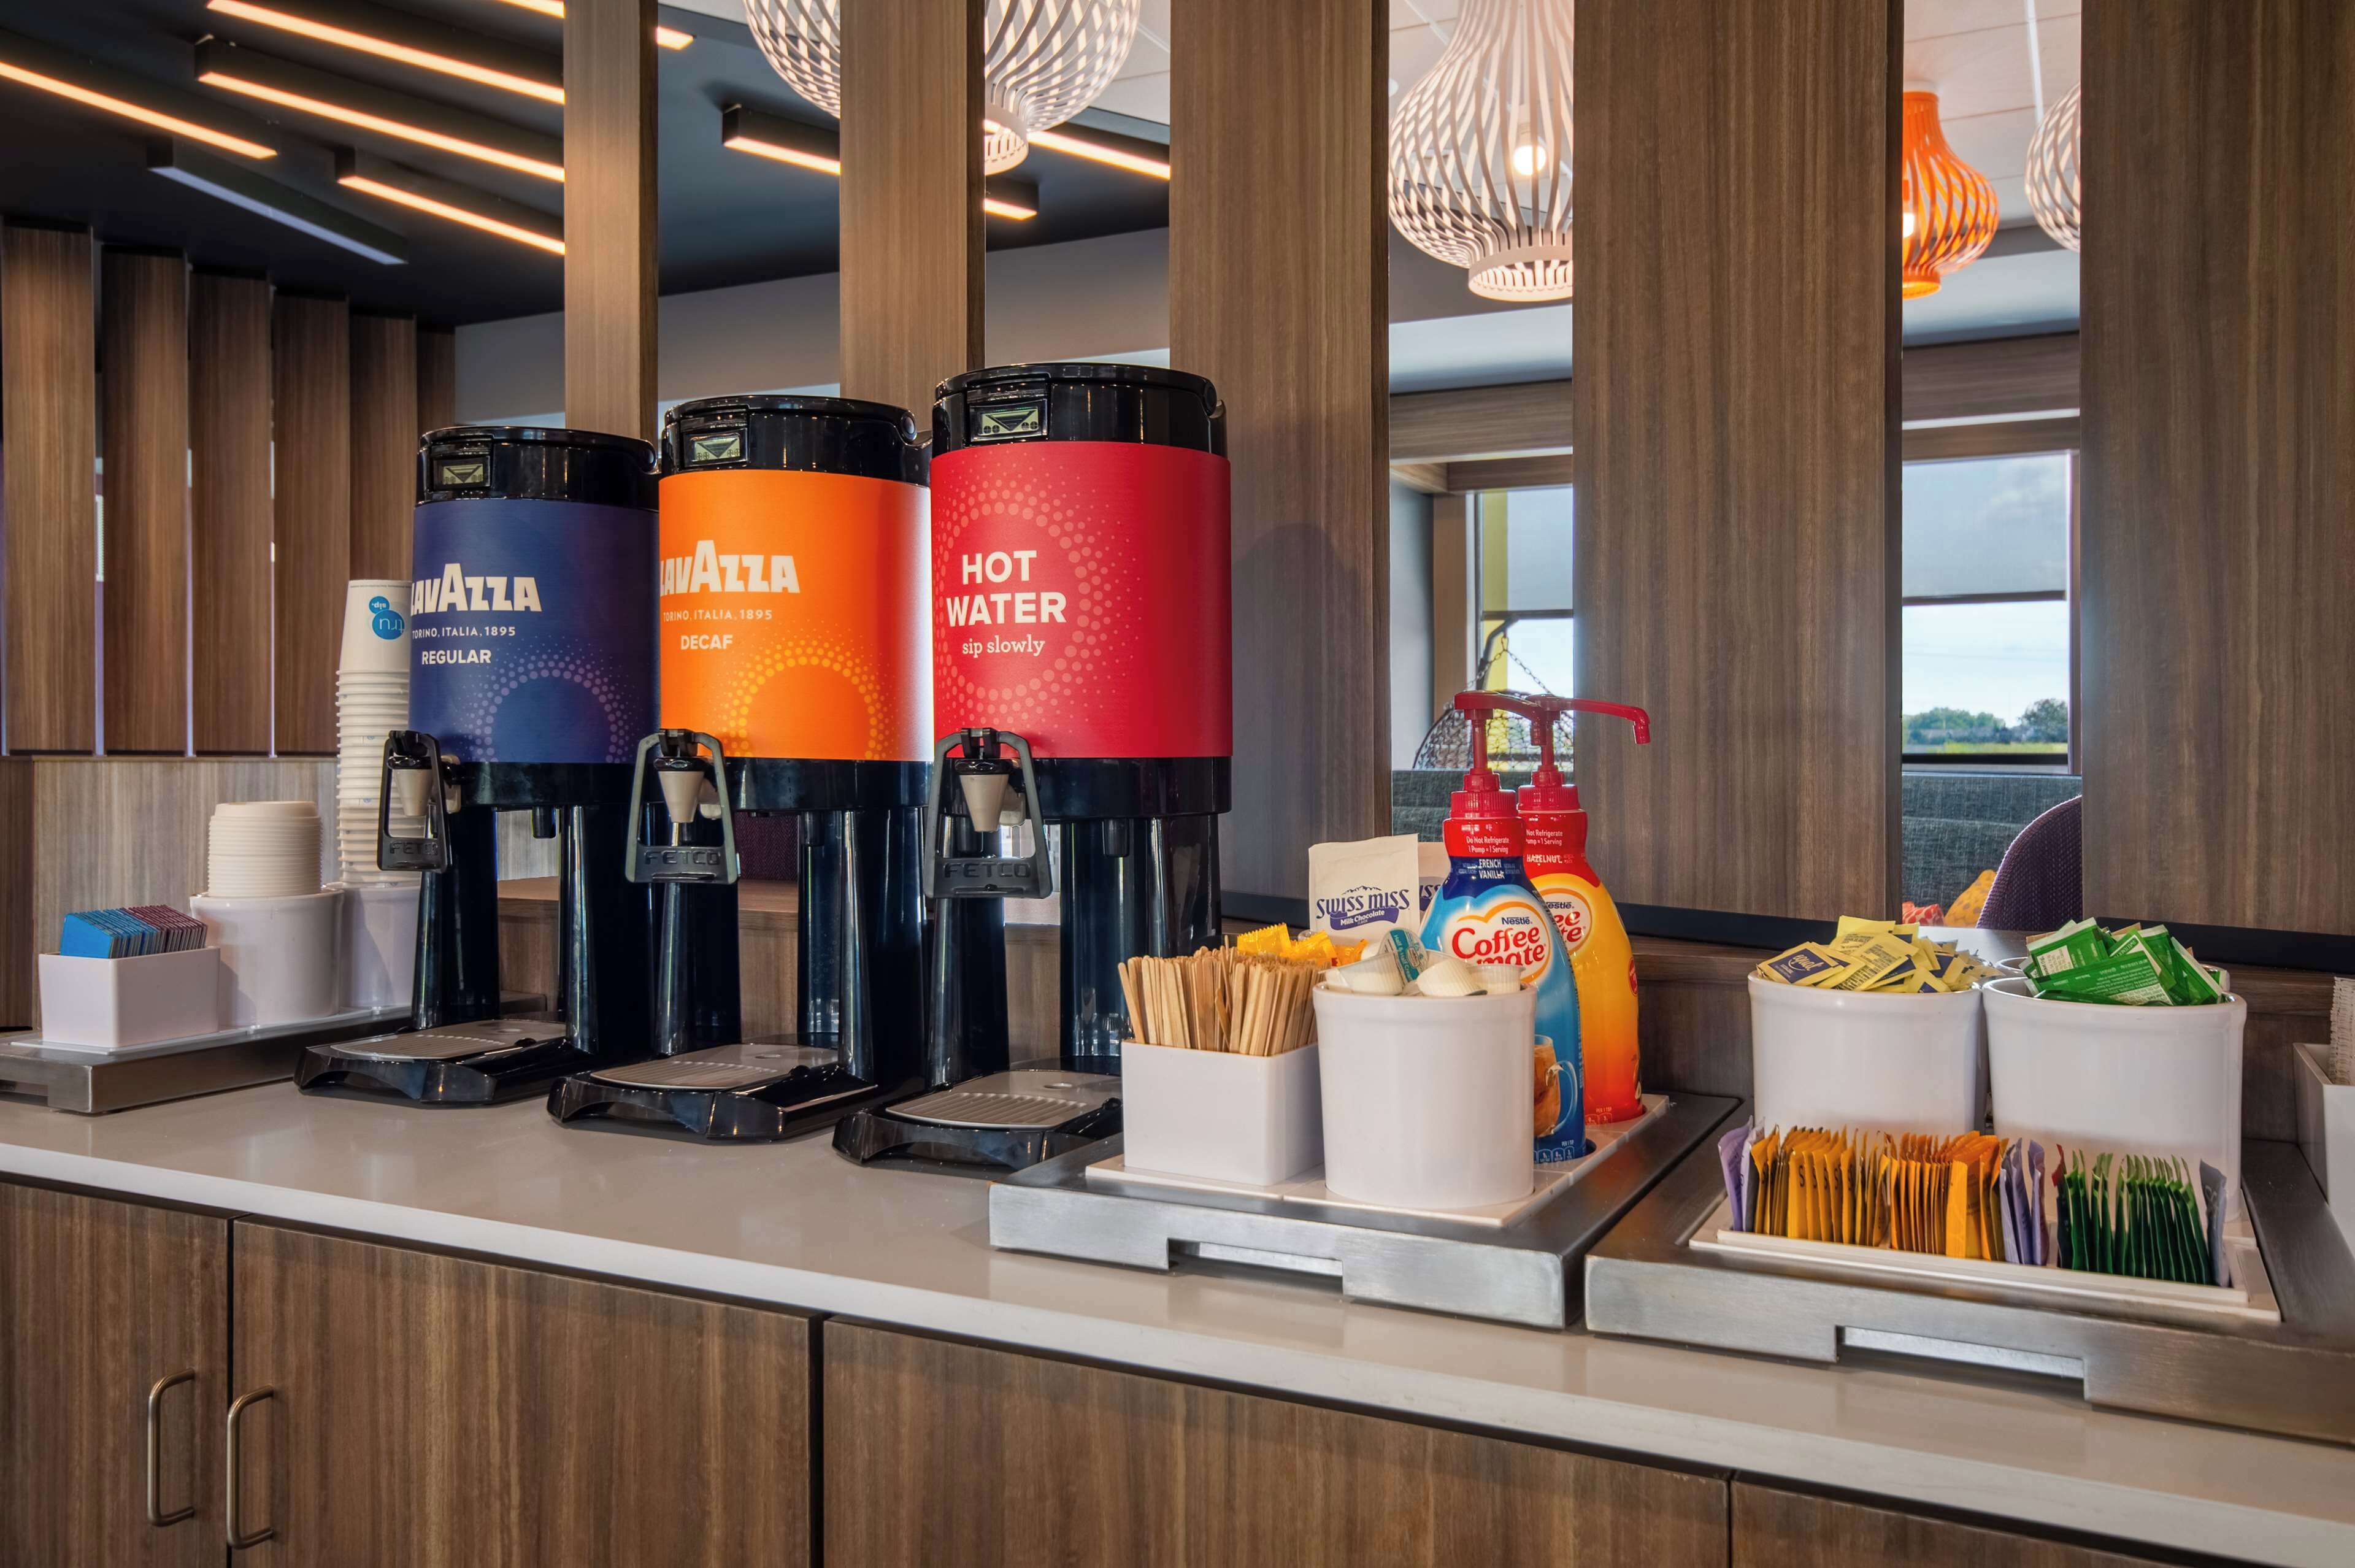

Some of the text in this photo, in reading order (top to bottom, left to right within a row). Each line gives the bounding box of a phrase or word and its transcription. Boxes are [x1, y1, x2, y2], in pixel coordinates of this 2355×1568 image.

[660, 540, 801, 597] LAVAZZA
[962, 550, 1037, 585] HOT
[410, 563, 542, 617] LAVAZZA
[739, 609, 773, 620] 1895
[946, 591, 1067, 627] WATER
[378, 618, 404, 634] tru
[484, 626, 516, 637] 1895
[680, 634, 733, 650] DECAF
[962, 634, 1045, 658] sip slowly
[421, 648, 491, 665] REGULAR
[1483, 836, 1509, 845] Refrigerate
[1535, 829, 1563, 839] Refrigerate
[644, 850, 721, 865] FETCO
[1478, 859, 1502, 868] FRENCH
[1526, 854, 1561, 863] HAZELNUT
[943, 862, 1032, 878] FETCO
[1478, 870, 1505, 879] VANILLA
[1316, 894, 1364, 919] SWISS
[1354, 909, 1385, 923] Chocolate
[1452, 927, 1540, 959] Coffee
[1791, 954, 1824, 971] equal
